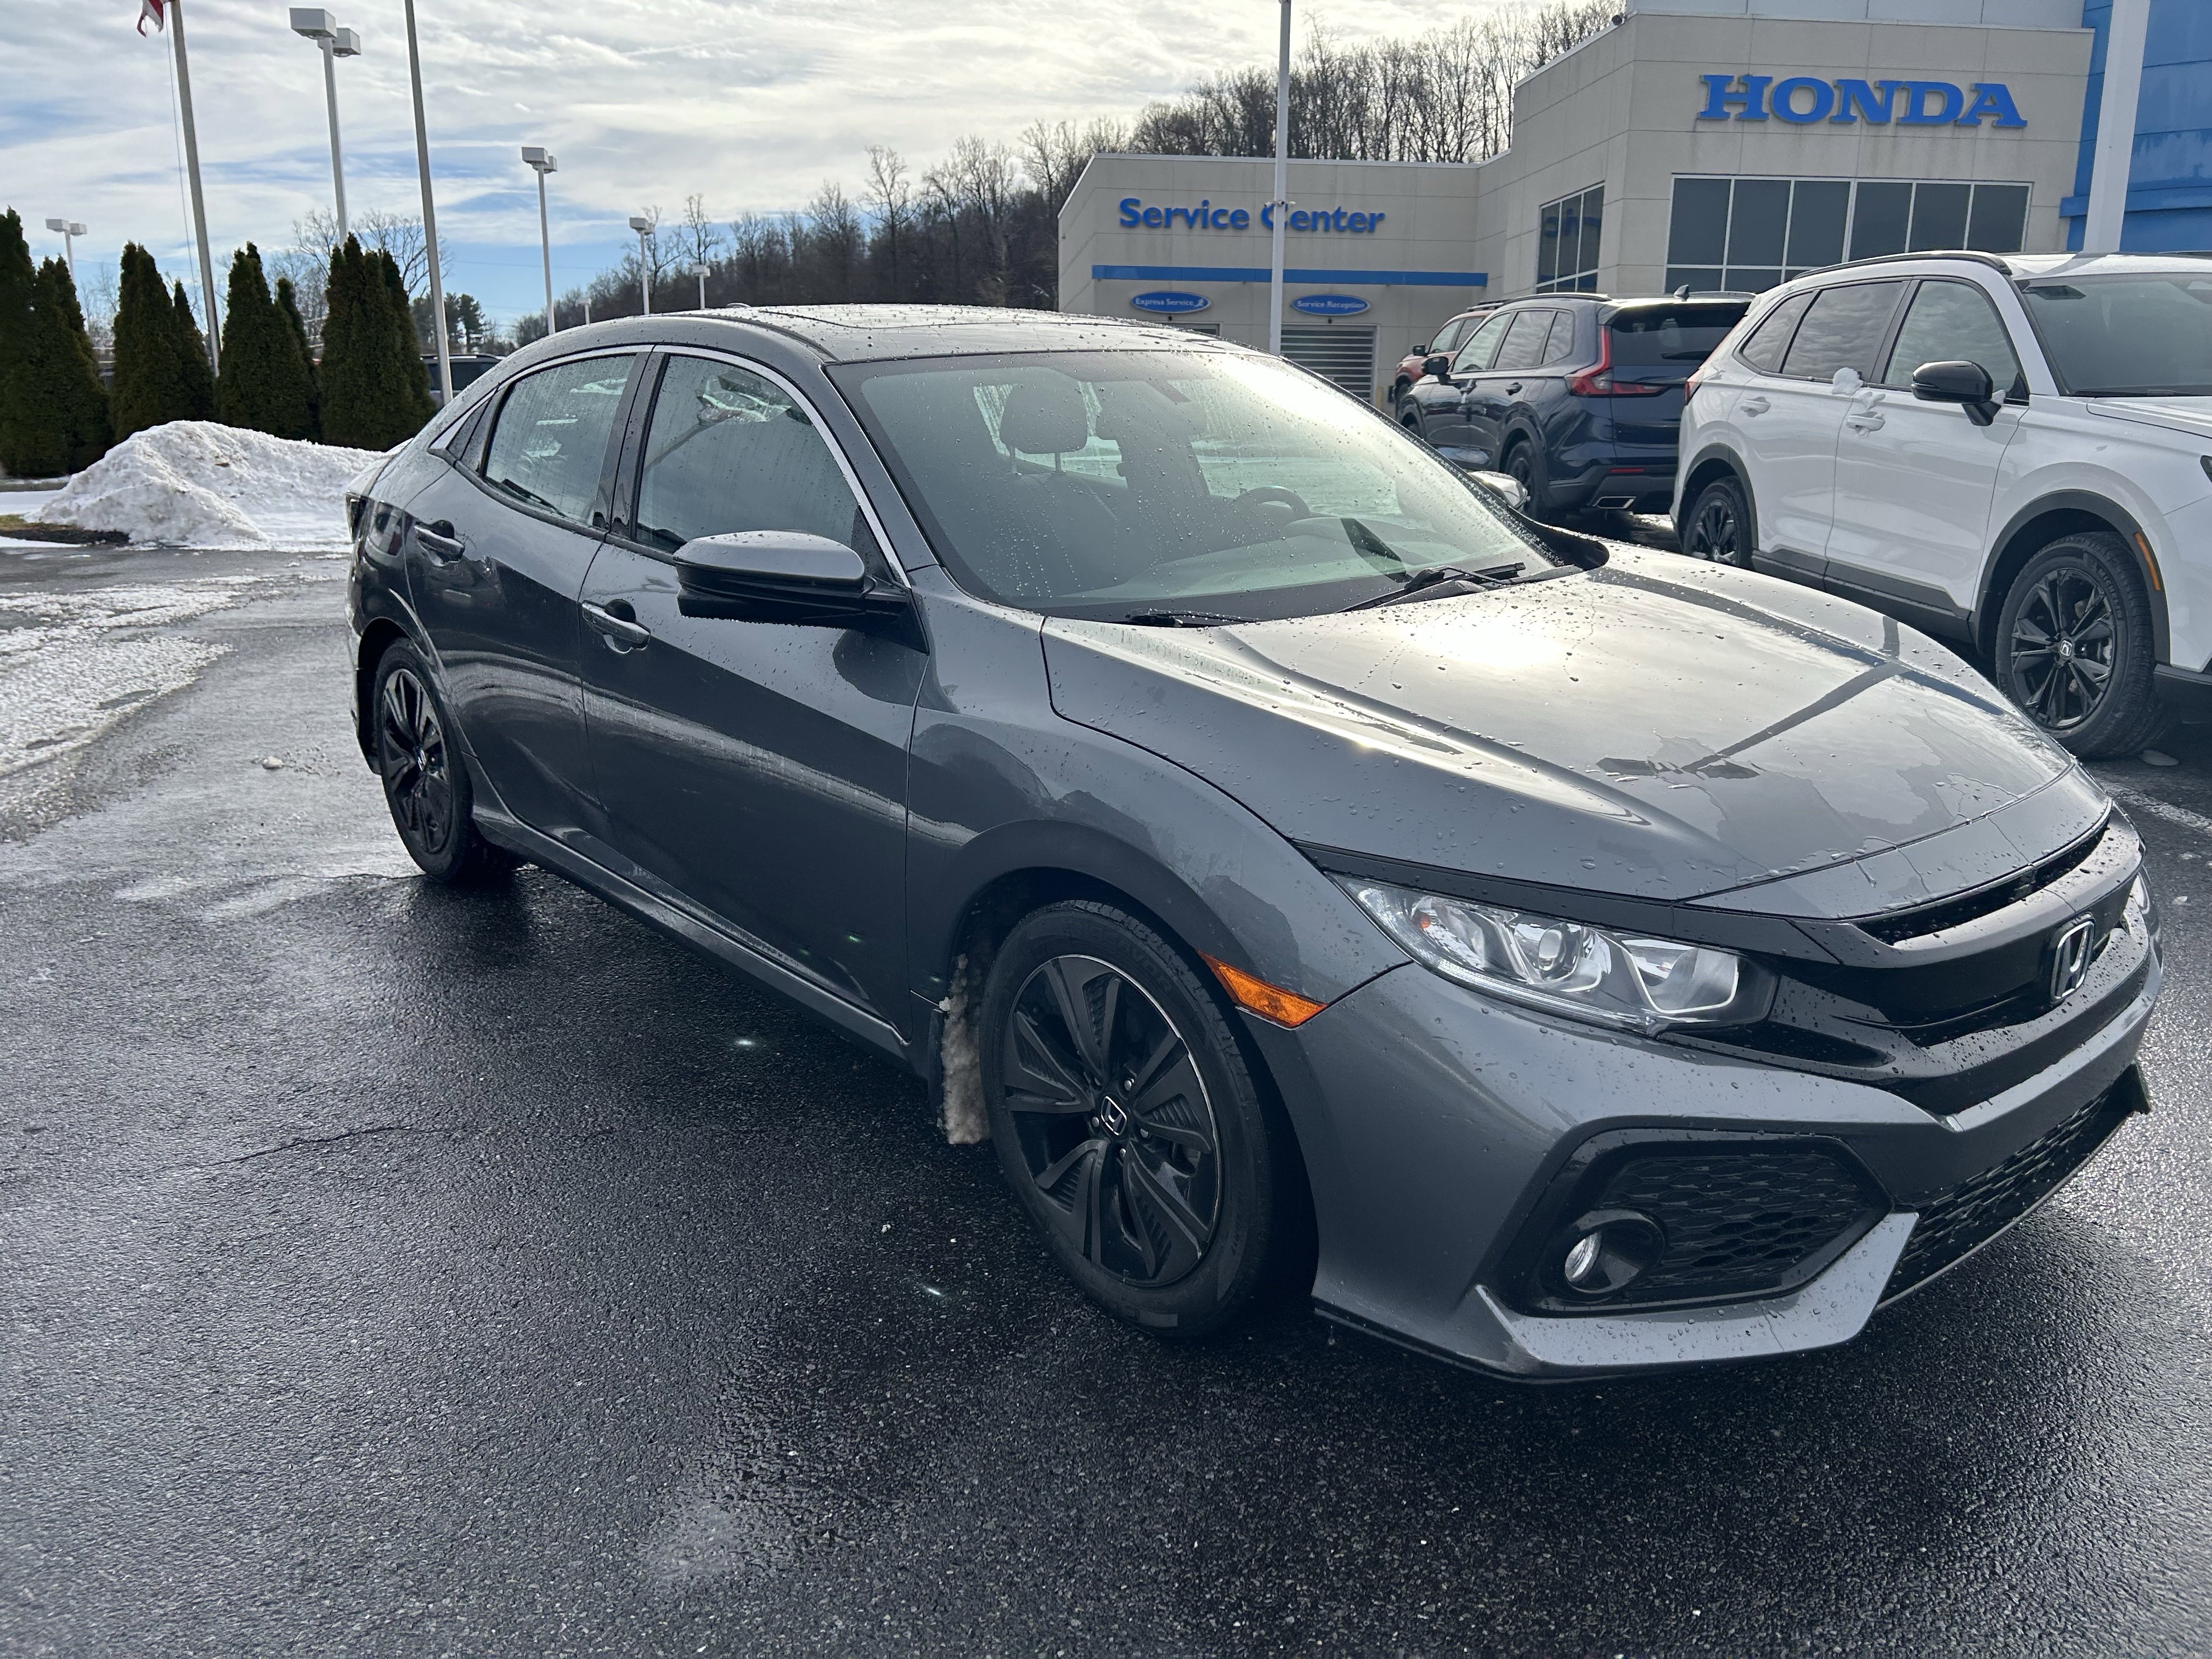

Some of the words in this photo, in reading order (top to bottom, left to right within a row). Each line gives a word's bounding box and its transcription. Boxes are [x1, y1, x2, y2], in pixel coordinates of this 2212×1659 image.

[1699, 75, 2028, 127] HONDA
[1119, 198, 1250, 229] Service
[1261, 202, 1385, 232] Center
[1136, 298, 1164, 306] Express
[2097, 568, 2123, 619] MICHELIN
